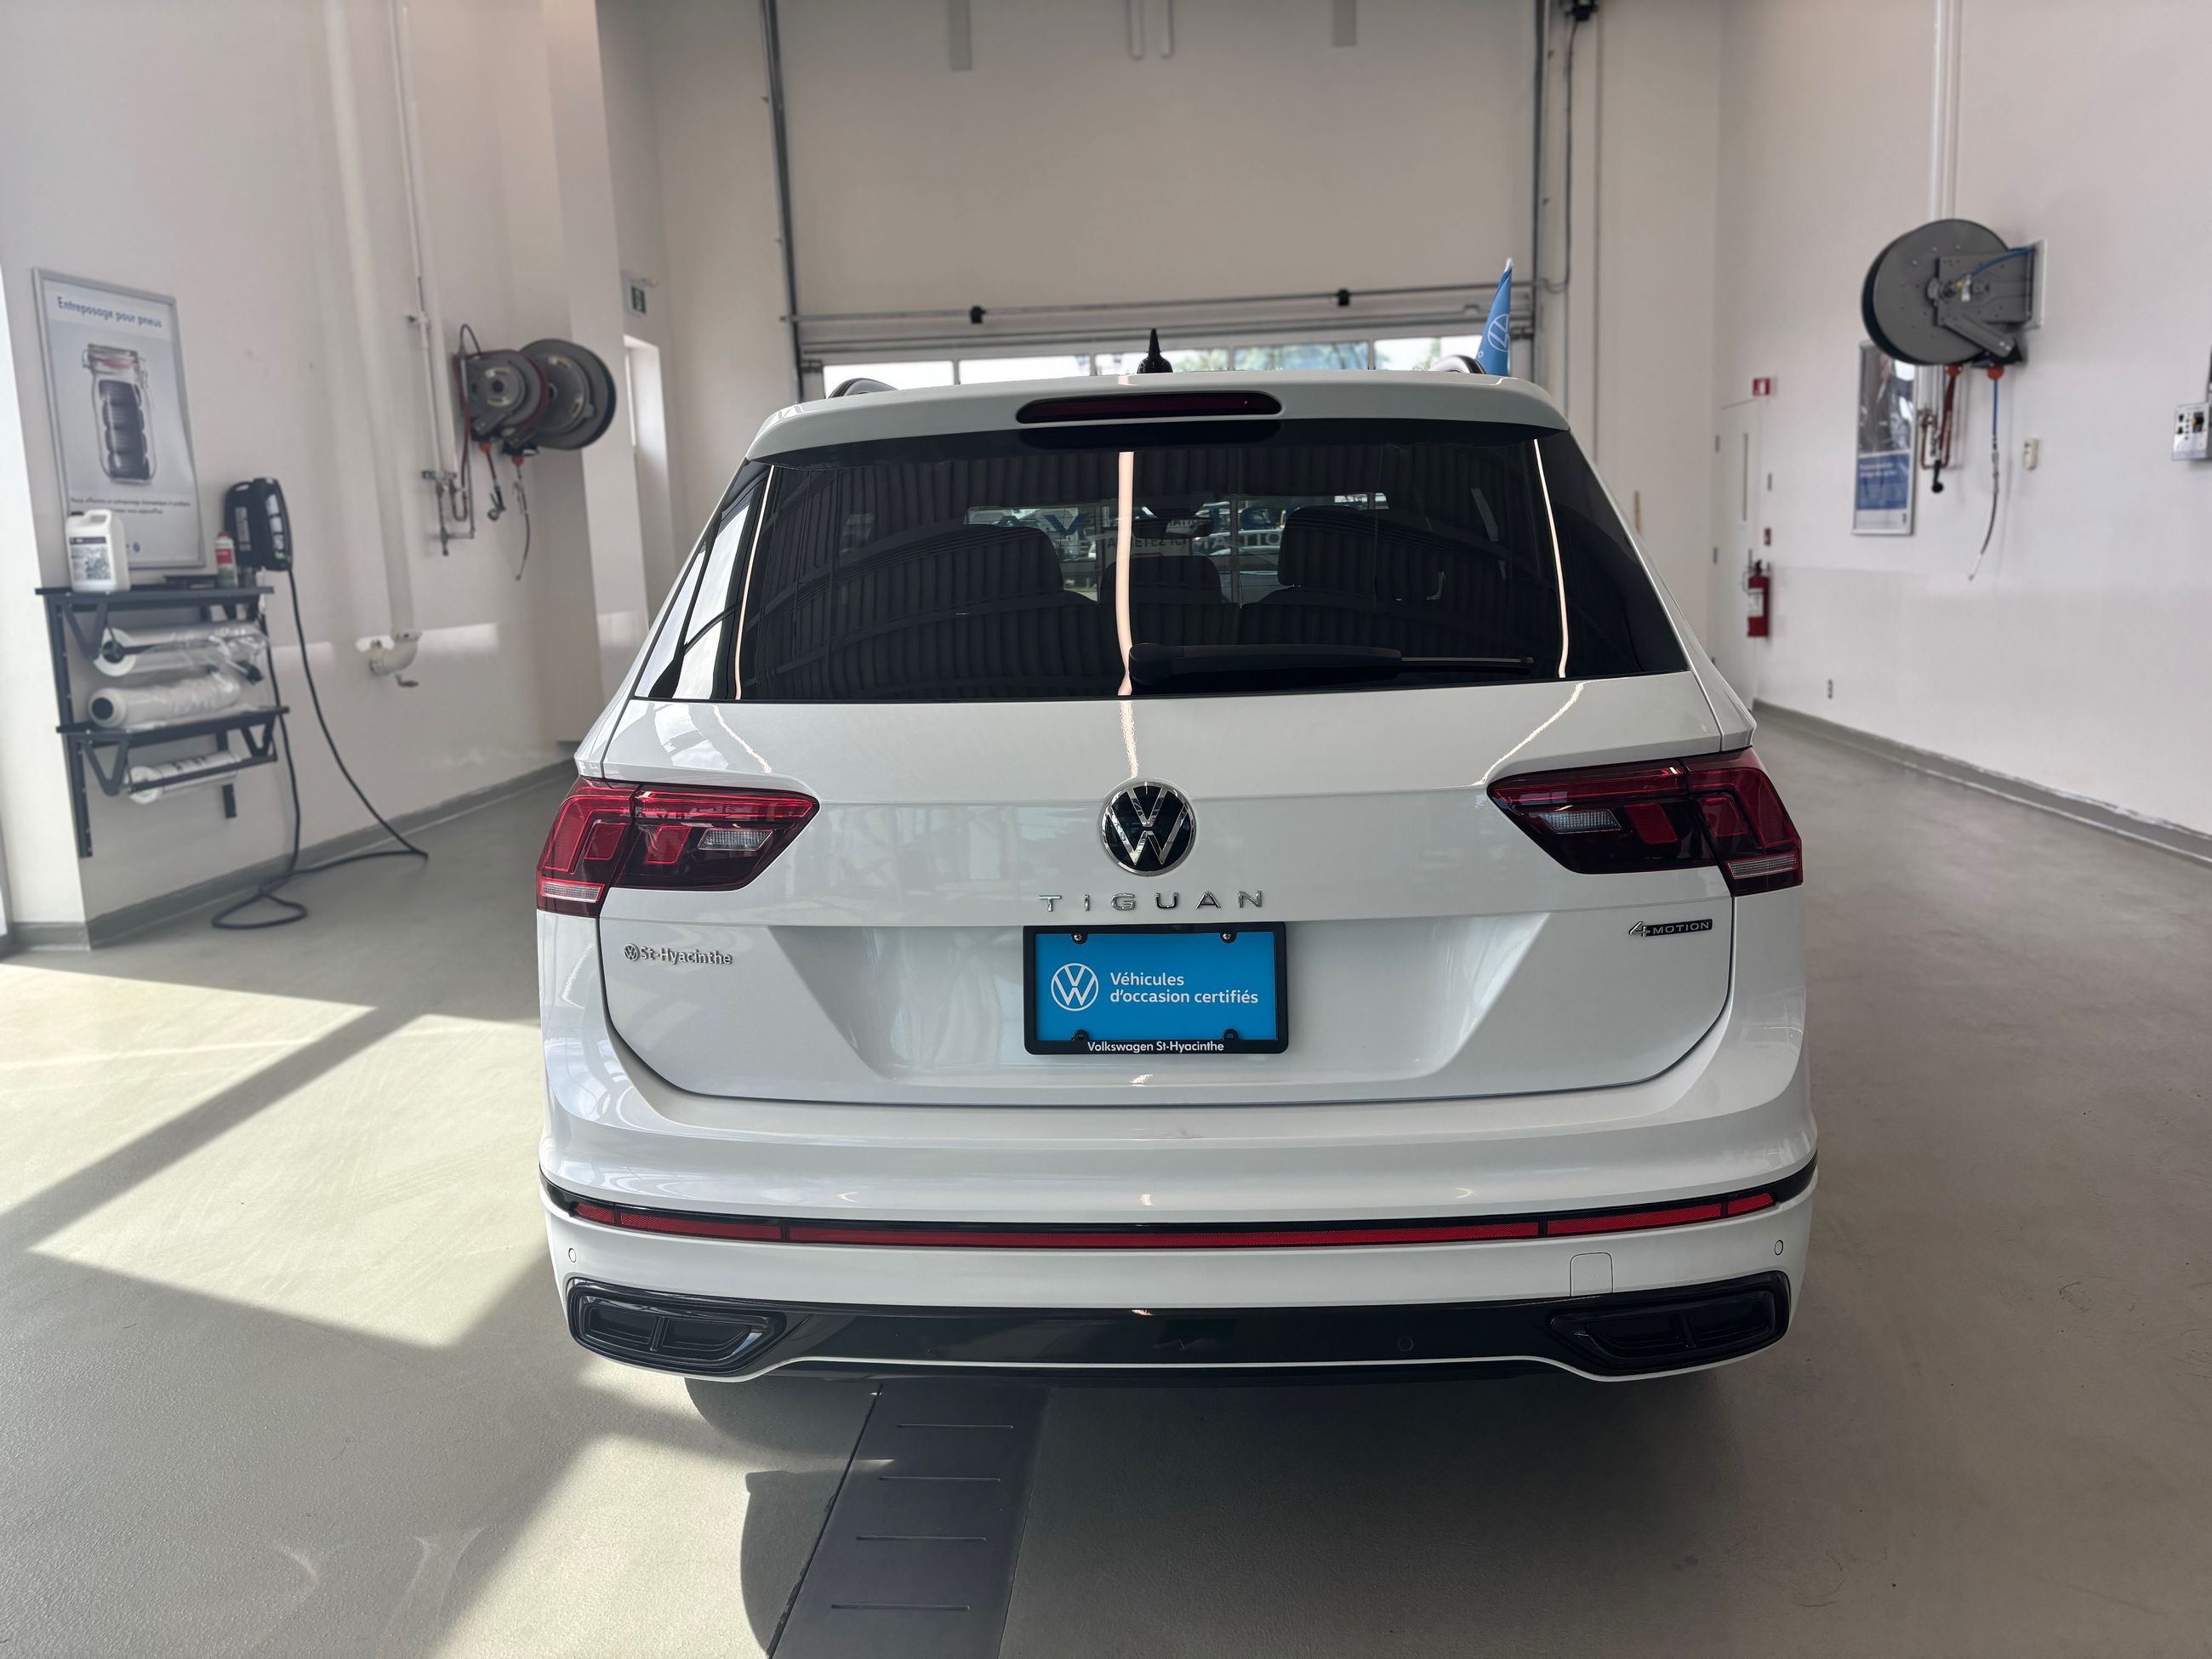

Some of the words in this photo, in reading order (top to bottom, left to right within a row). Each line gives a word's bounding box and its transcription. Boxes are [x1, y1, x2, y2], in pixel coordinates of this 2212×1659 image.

[1038, 890, 1264, 912] TIGUAN
[1629, 920, 1711, 938] 4MOTION
[640, 945, 733, 965] St-Hyacinthe
[1110, 972, 1184, 987] Véhicules
[1110, 989, 1189, 1004] d'occasion
[1194, 989, 1258, 1005] certifiés
[1087, 1040, 1154, 1052] Volkswagen
[1156, 1040, 1224, 1053] St-Hyacinthe
